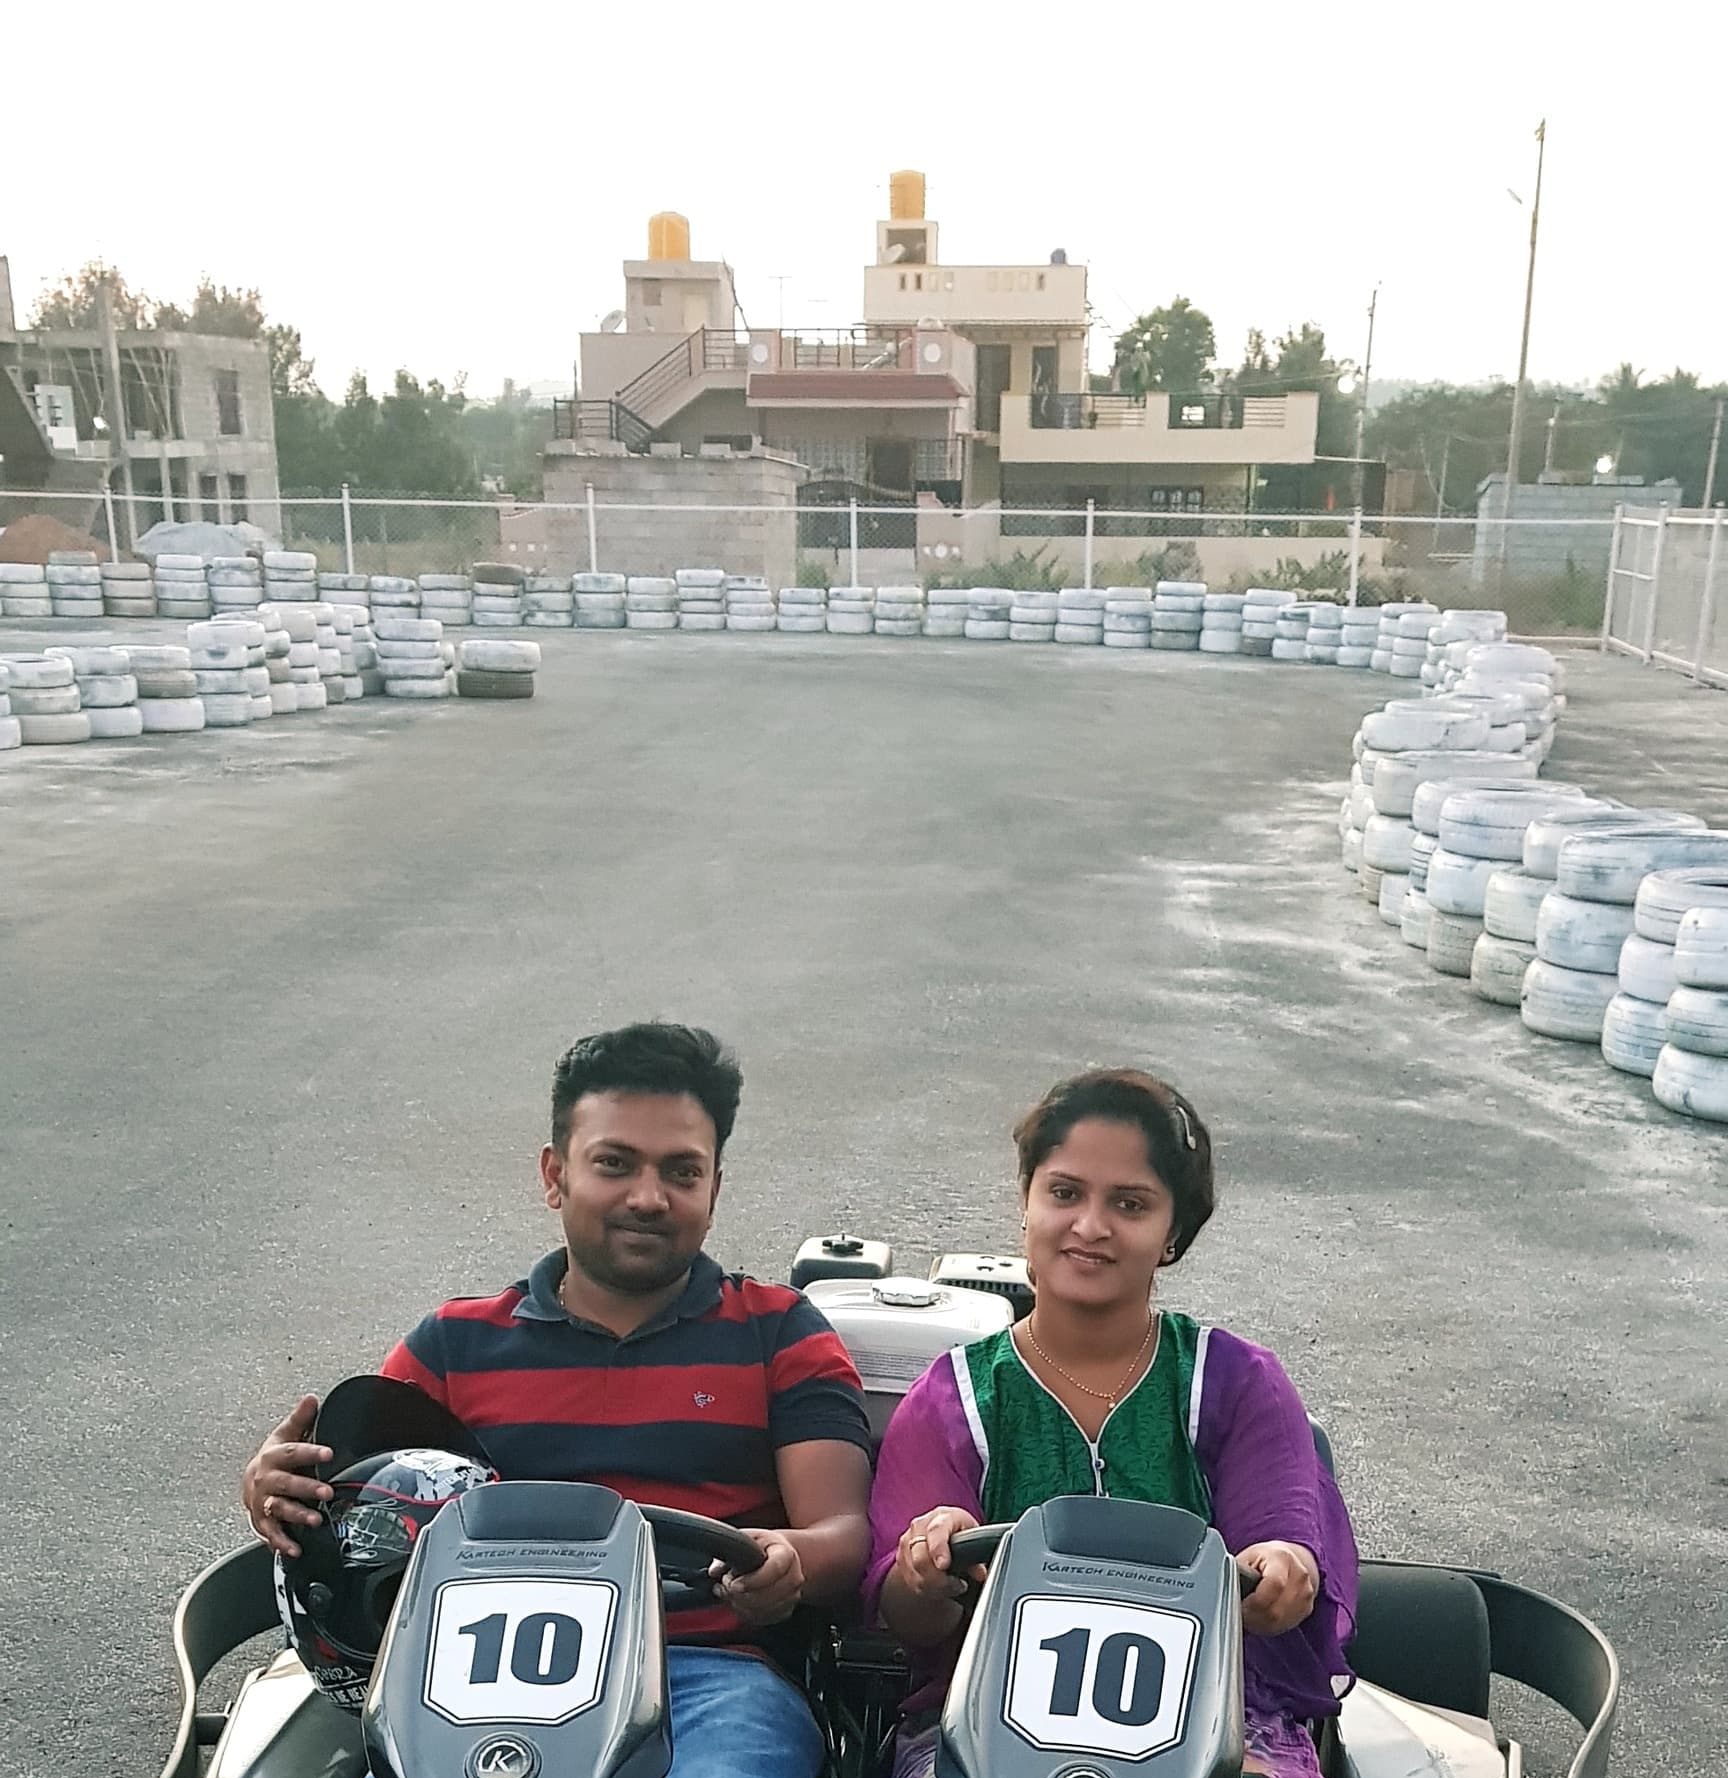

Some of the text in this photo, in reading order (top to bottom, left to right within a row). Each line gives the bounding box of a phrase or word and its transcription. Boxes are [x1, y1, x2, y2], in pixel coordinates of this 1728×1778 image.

[456, 1549, 608, 1560] KARTECH ENGINEERING
[1042, 1562, 1195, 1589] KARTECH ENGINEERING
[458, 1612, 583, 1686] 10
[1040, 1627, 1166, 1727] 10
